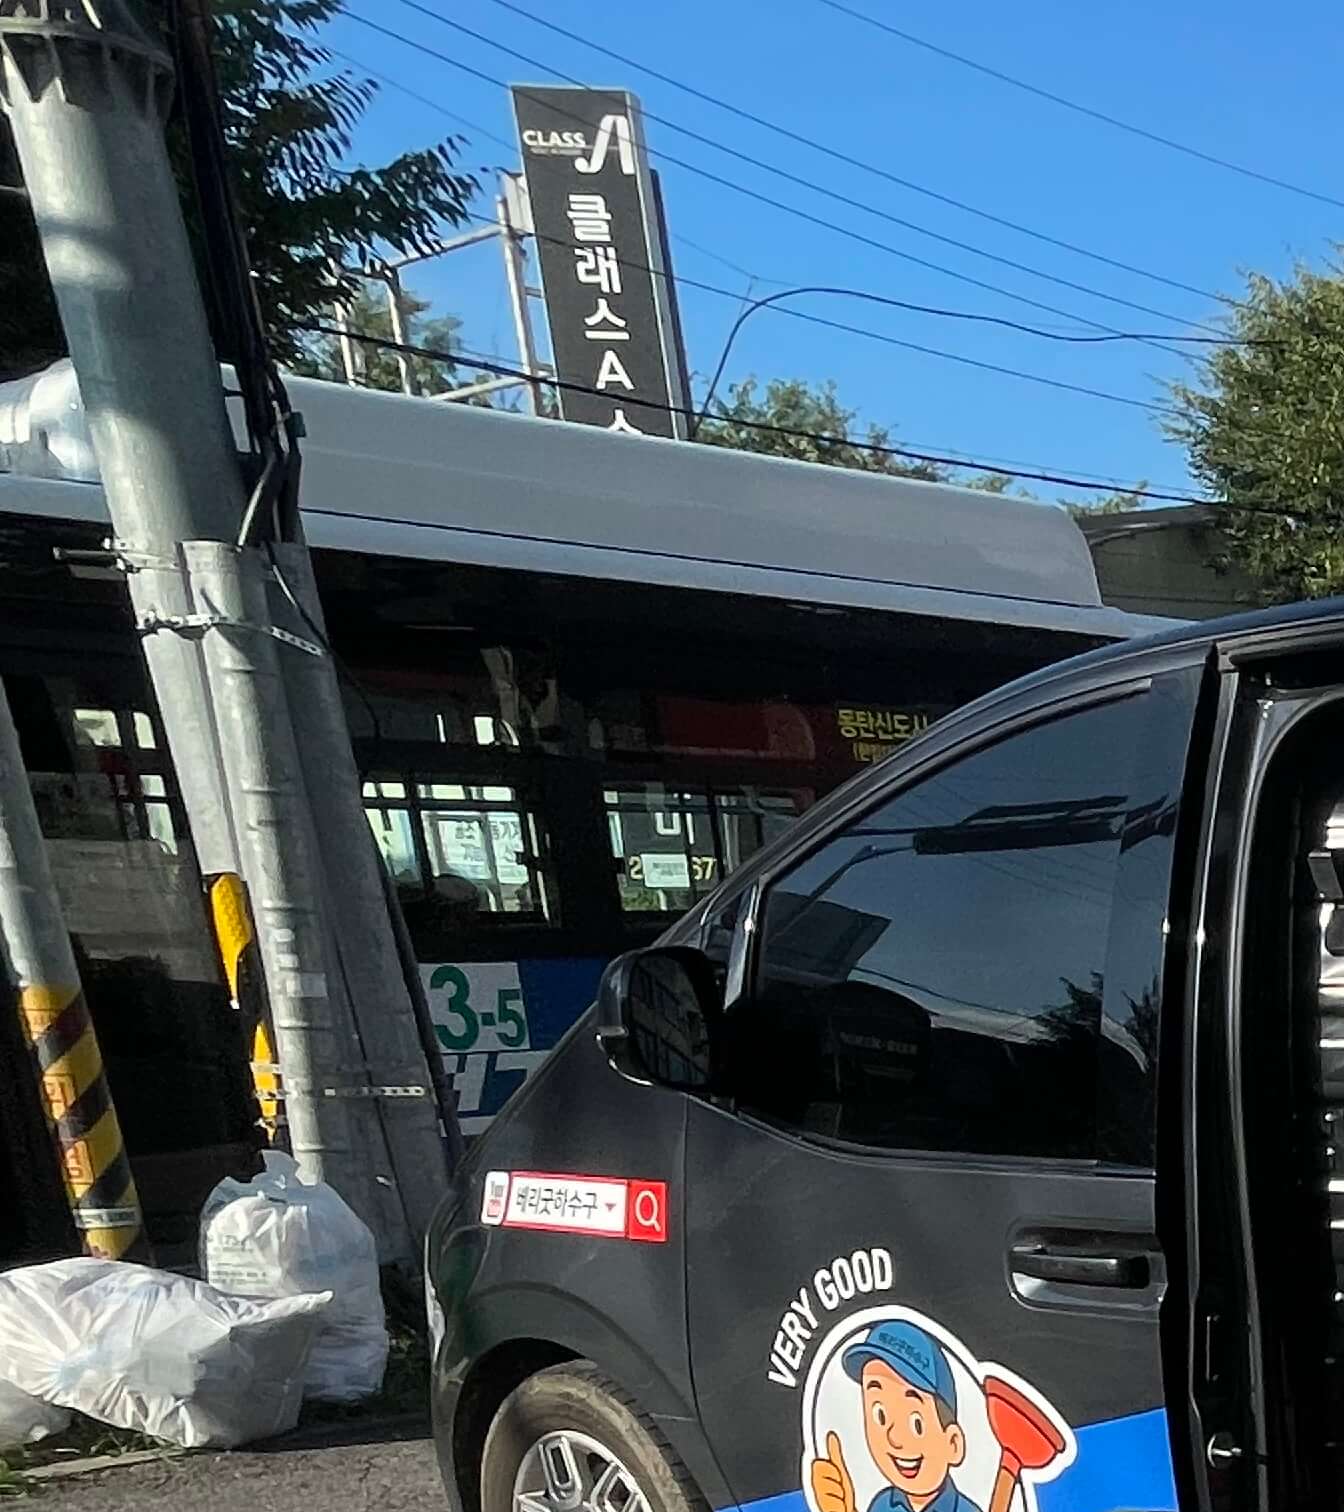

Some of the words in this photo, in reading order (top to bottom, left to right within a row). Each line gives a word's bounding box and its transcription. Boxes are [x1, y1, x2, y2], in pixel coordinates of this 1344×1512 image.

[523, 130, 587, 147] CLASS
[768, 1287, 818, 1387] VERY
[814, 1248, 893, 1311] GOOD
